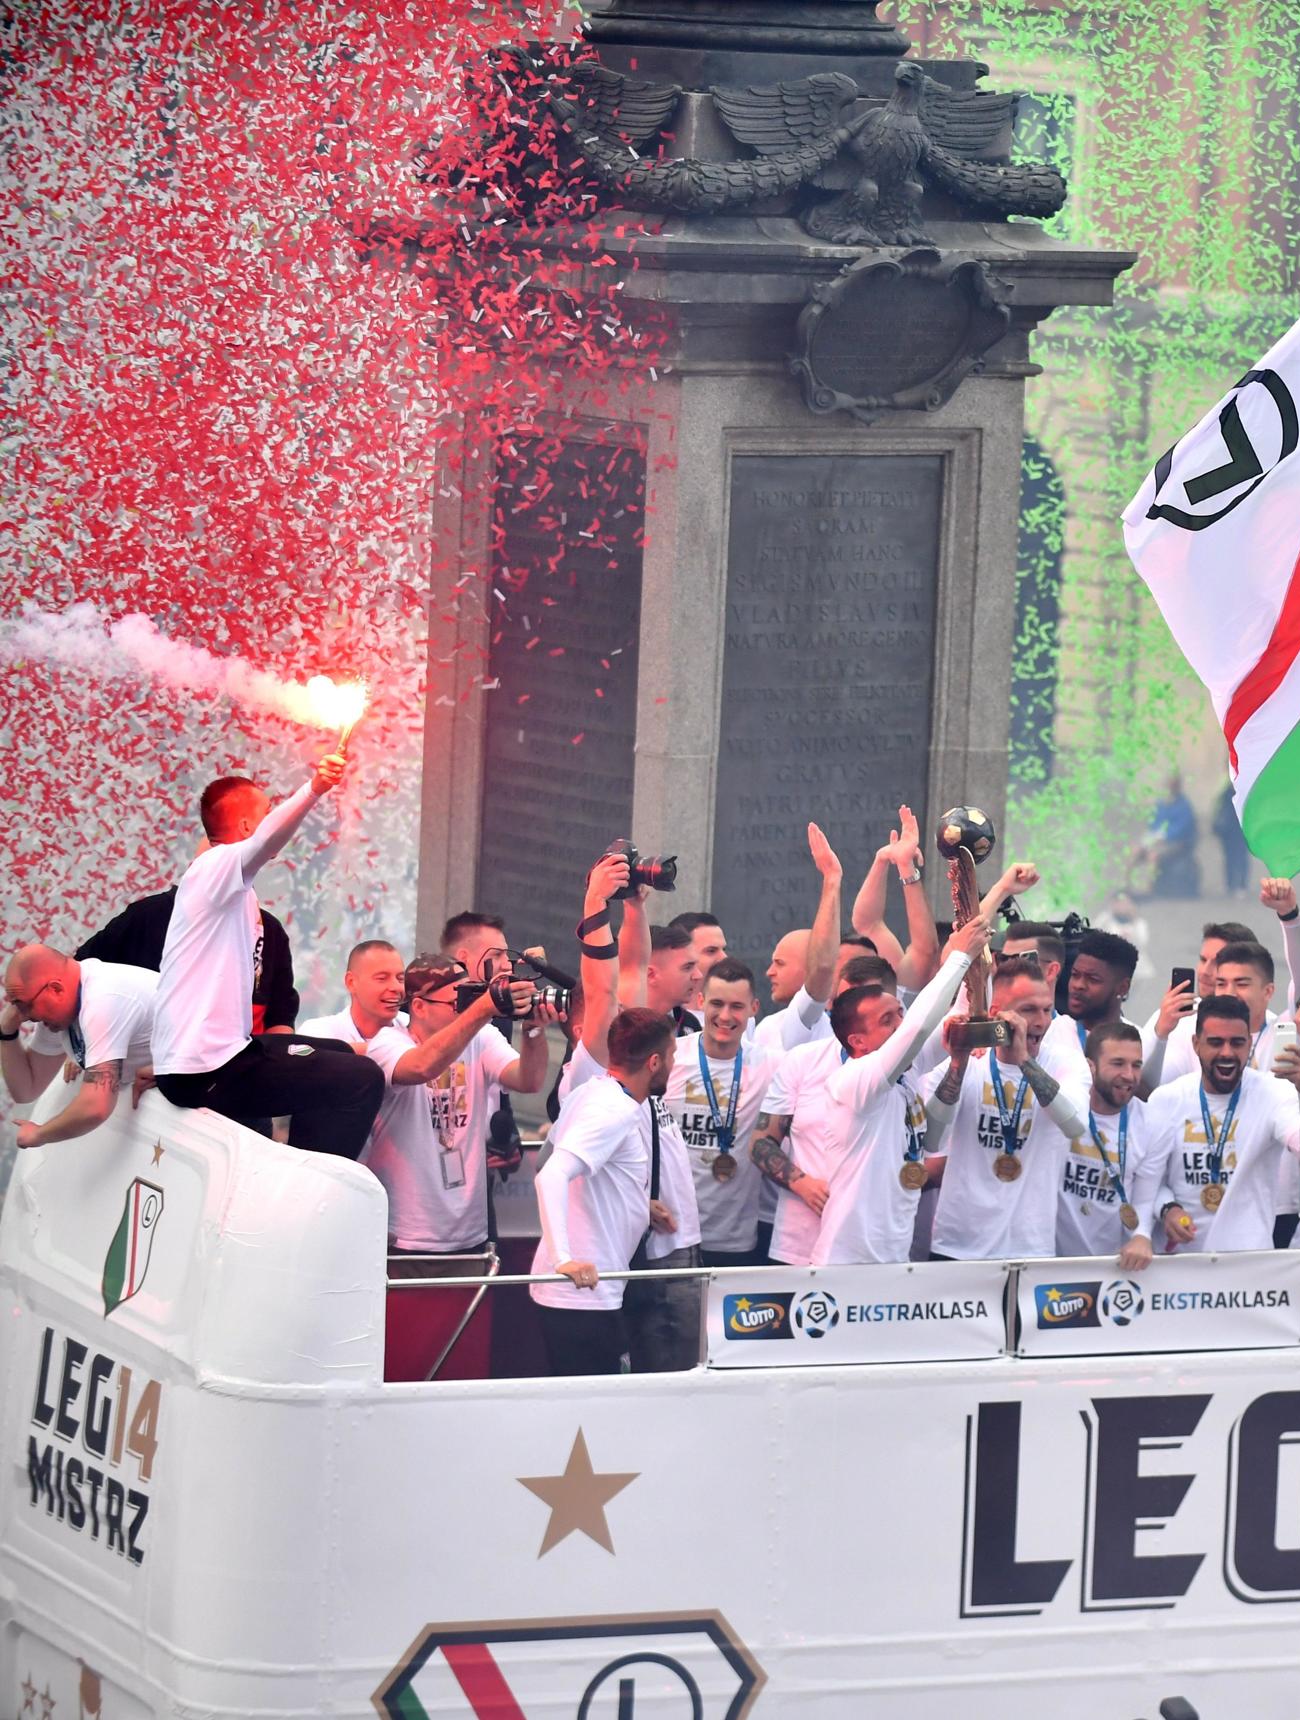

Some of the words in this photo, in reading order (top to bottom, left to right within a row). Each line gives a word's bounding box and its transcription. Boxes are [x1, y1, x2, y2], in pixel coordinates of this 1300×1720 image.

[792, 517, 877, 535] SCRAM
[977, 1113, 1033, 1135] LE4
[682, 1131, 736, 1148] MISTZ
[977, 1133, 1028, 1151] MISR
[1182, 1151, 1238, 1170] LEG4
[1184, 1171, 1235, 1185] MISR
[1063, 1179, 1117, 1203] MISTRZ
[741, 1307, 775, 1328] LOTTO
[846, 1300, 989, 1323] EKSTRAKLASA
[1053, 1297, 1084, 1317] LOTTO
[1151, 1290, 1291, 1311] EKSTRAKLASA
[30, 1326, 162, 1483] LEG14
[28, 1435, 150, 1567] MISTRZ
